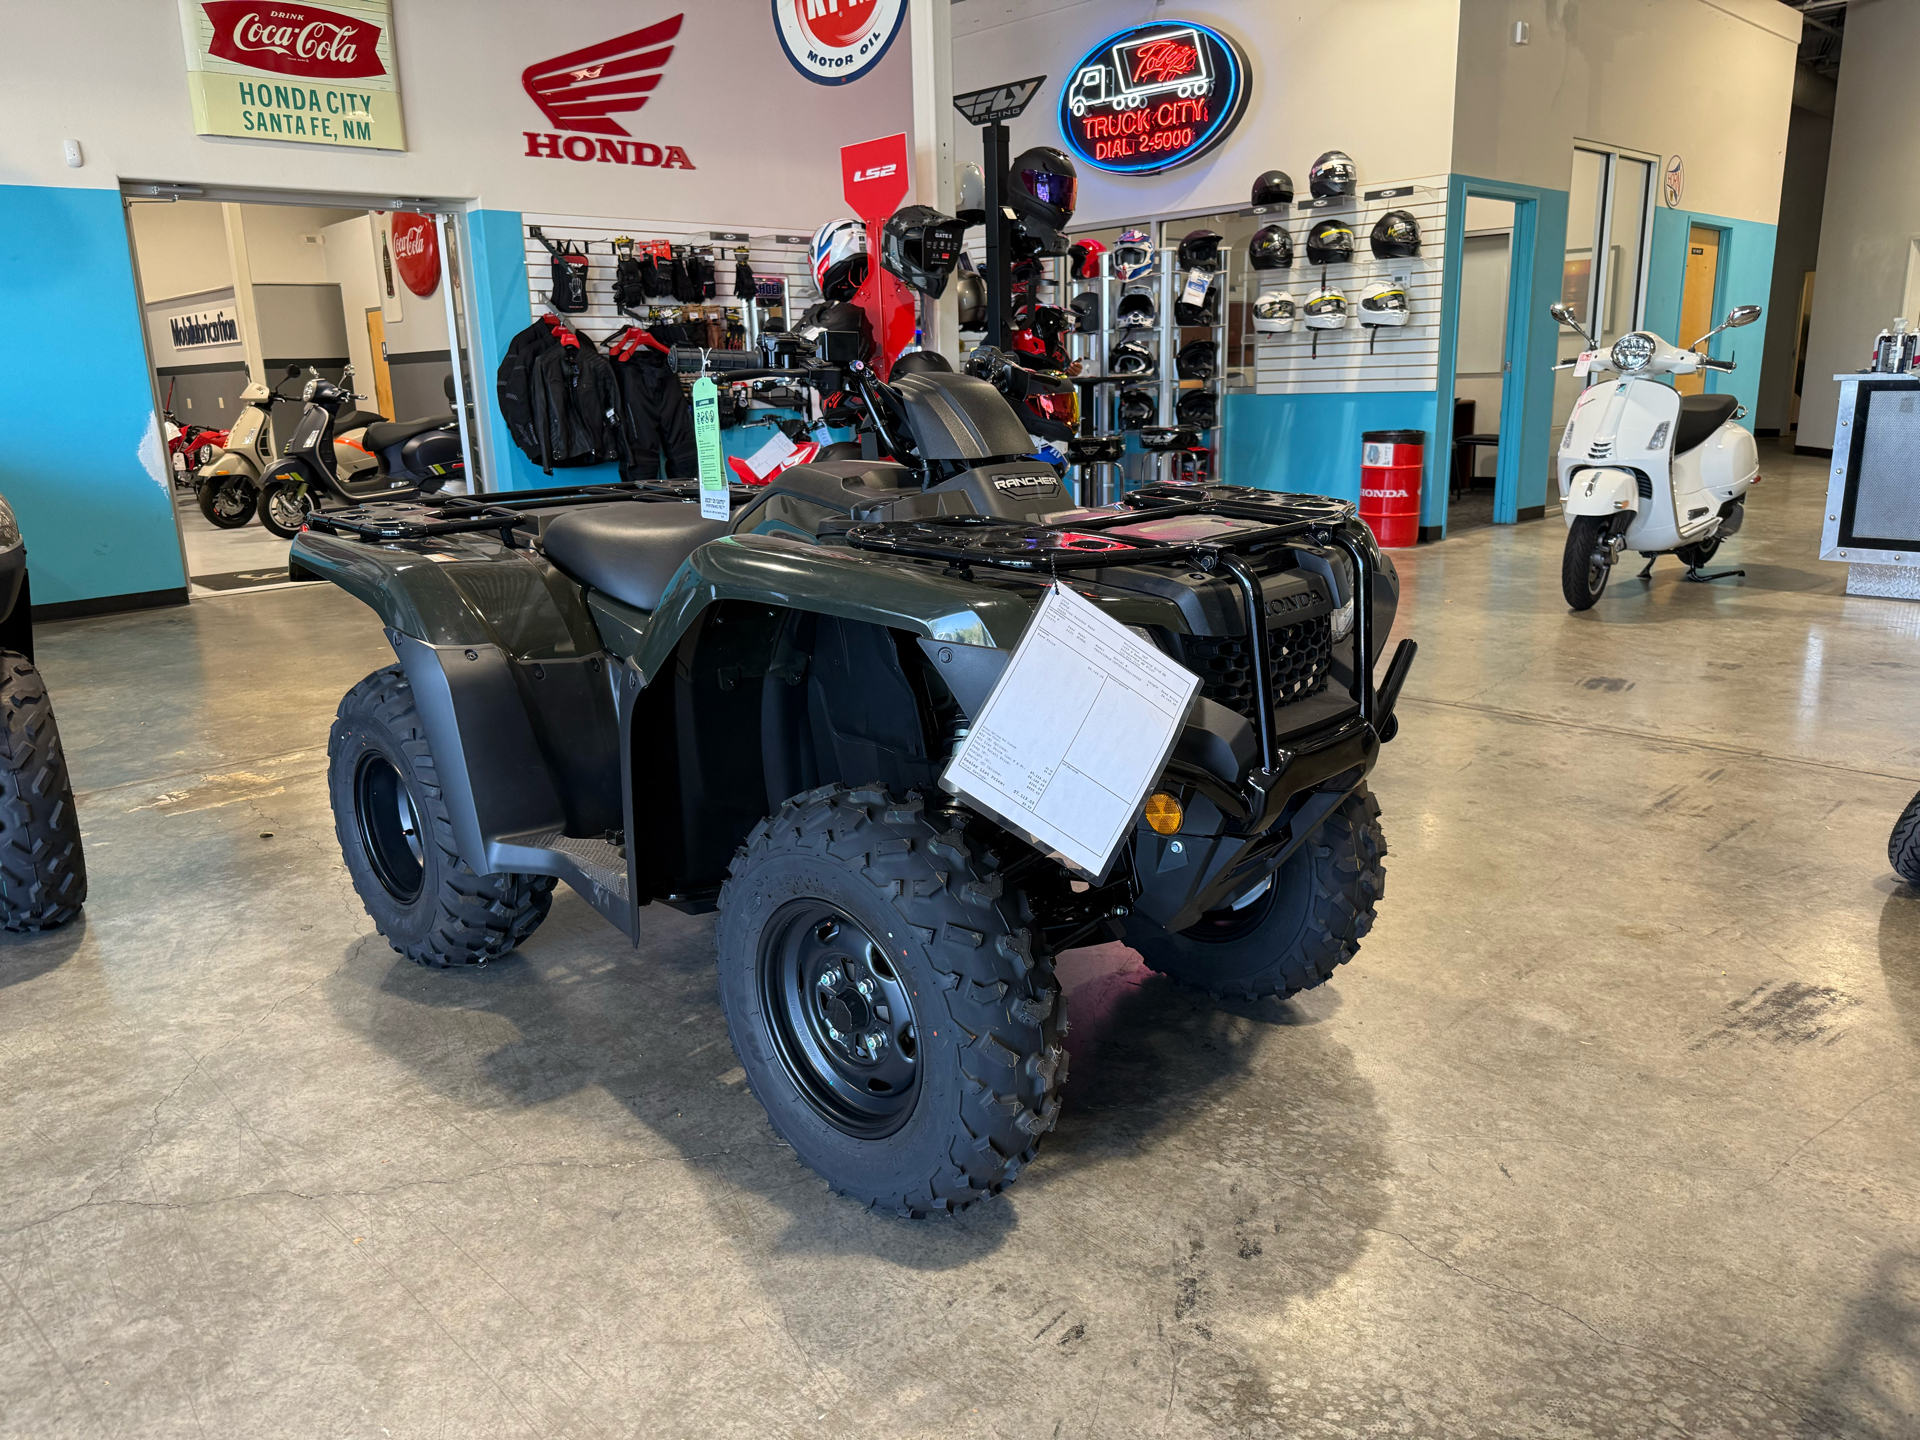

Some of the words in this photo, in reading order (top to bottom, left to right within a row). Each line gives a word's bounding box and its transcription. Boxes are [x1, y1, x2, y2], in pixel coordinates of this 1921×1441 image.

[270, 10, 304, 21] DRINK
[233, 12, 359, 63] Coca-Cola
[806, 50, 854, 68] MOTOR
[860, 32, 881, 55] OIL
[238, 82, 322, 113] HONDA
[326, 91, 372, 116] CITY
[953, 80, 1037, 117] FLY
[971, 107, 1021, 122] RACING
[242, 110, 306, 135] SANTA
[310, 117, 338, 142] FE,
[342, 120, 372, 140] NM
[1083, 108, 1150, 139] TRUCK
[1157, 98, 1206, 126] CITY
[522, 132, 697, 170] HONDA
[1096, 142, 1132, 160] DIAL
[1139, 128, 1192, 152] 2-5000
[854, 164, 896, 182] LS2
[1050, 448, 1062, 458] FLY
[994, 476, 1058, 490] RANCHER
[1360, 489, 1408, 498] HONDA
